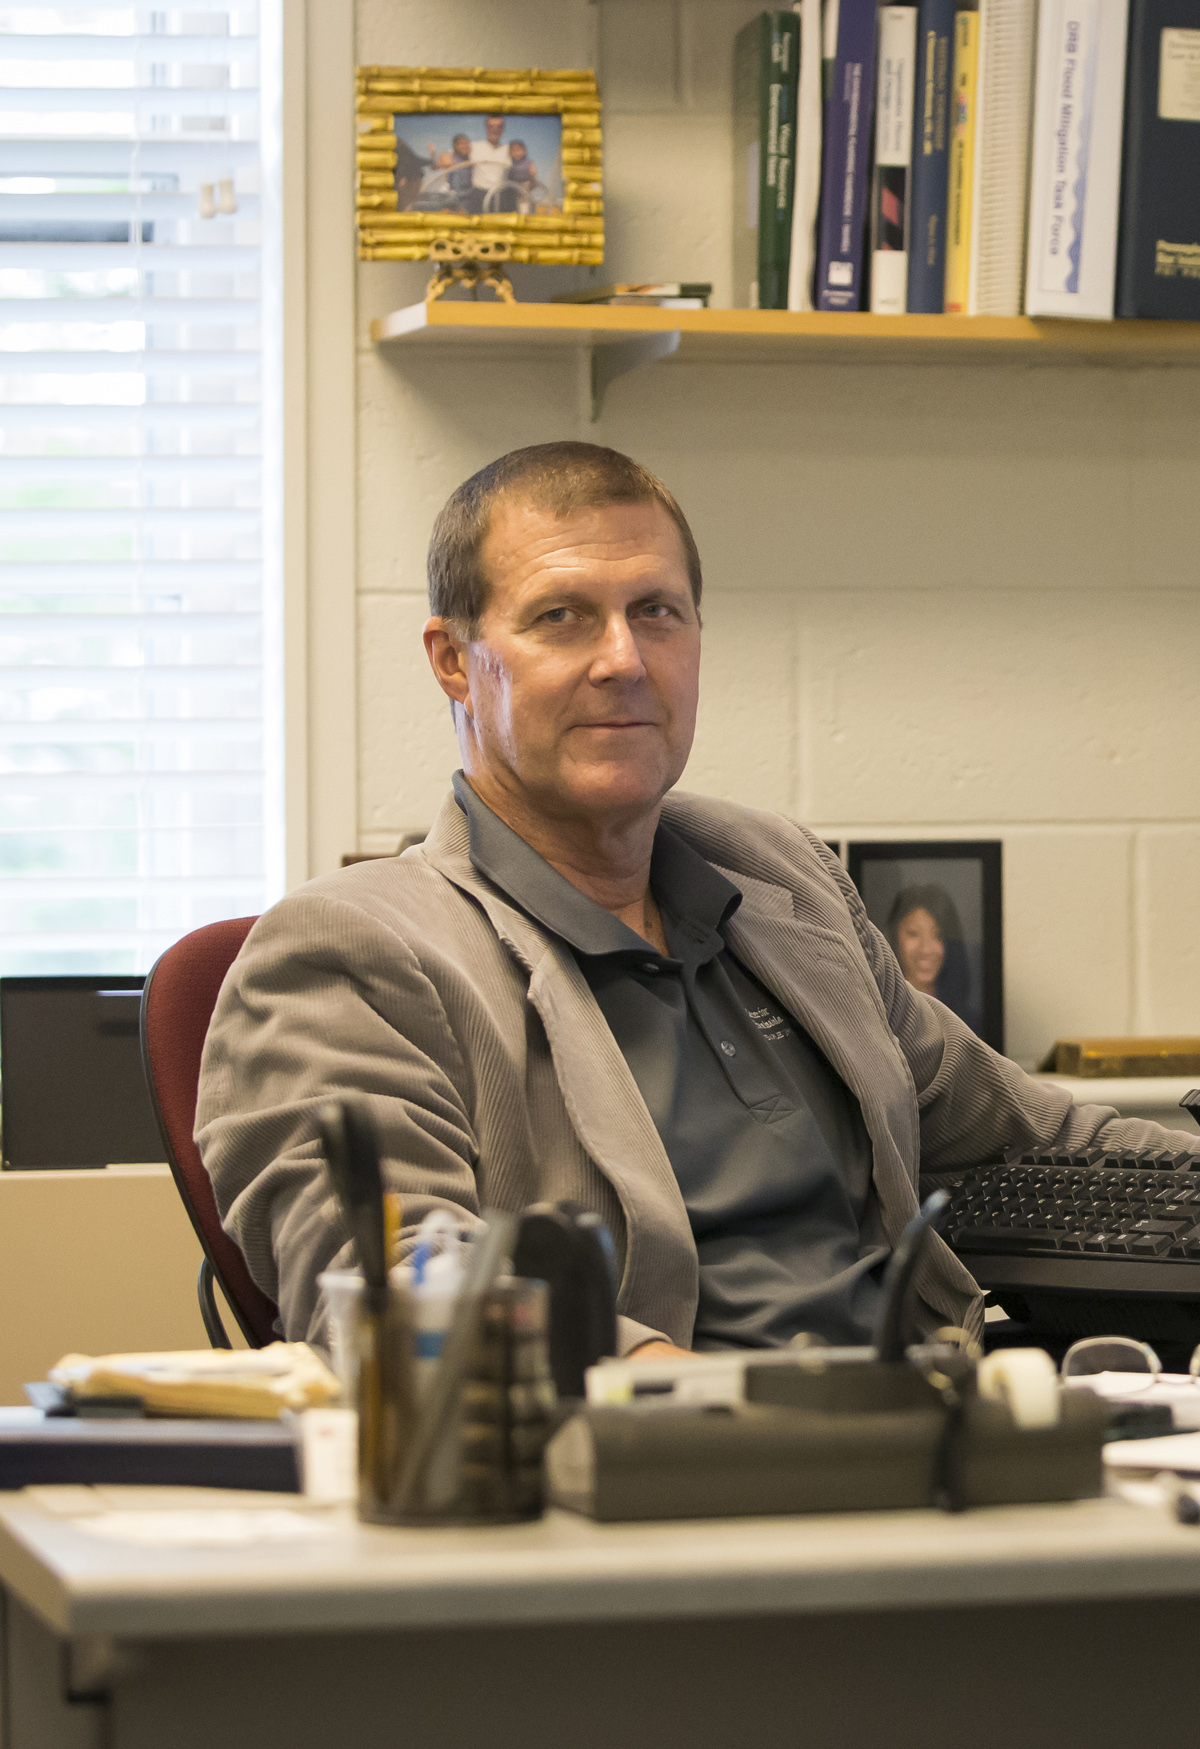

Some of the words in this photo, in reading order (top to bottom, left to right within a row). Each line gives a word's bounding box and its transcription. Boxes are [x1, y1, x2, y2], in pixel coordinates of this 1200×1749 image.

[1065, 20, 1082, 54] DRB
[1060, 58, 1077, 99] Flood
[1054, 103, 1074, 173] Mitigation
[1052, 179, 1068, 209] Task
[1049, 214, 1065, 256] Force
